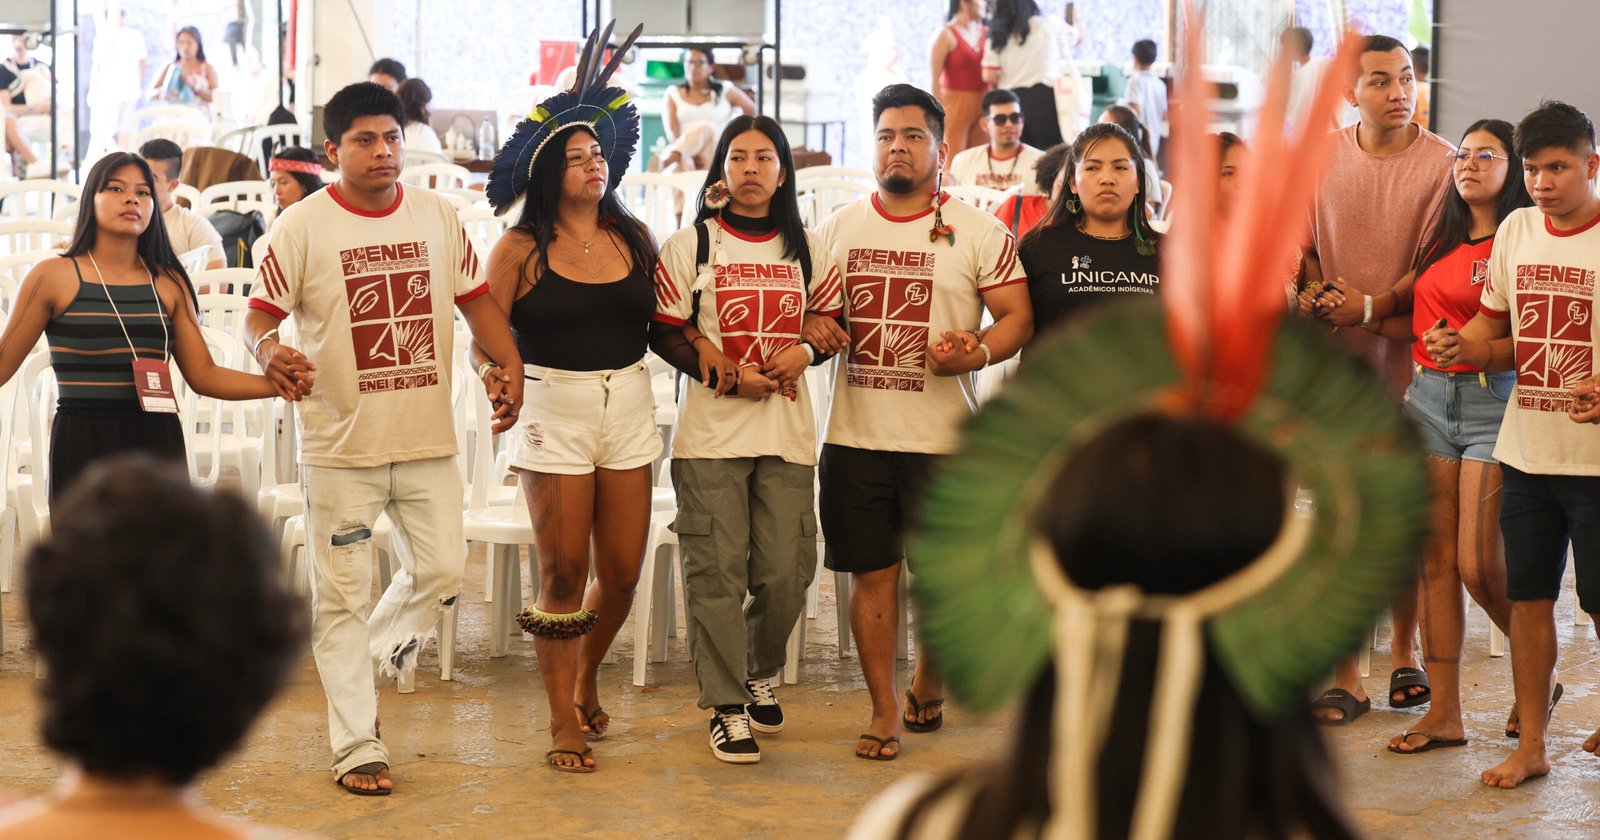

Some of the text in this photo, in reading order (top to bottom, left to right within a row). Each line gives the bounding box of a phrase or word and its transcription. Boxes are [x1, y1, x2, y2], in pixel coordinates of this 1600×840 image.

[365, 242, 420, 262] ENEI
[419, 241, 429, 257] 2024
[871, 249, 927, 267] ENEI
[926, 253, 936, 268] 2024
[740, 264, 793, 279] ENEI
[1061, 271, 1160, 286] UNICAMP
[1535, 264, 1587, 285] ENEI
[1586, 270, 1596, 287] 2024
[1068, 285, 1154, 295] ACADÊMICOS INDÍGENAS
[359, 378, 389, 391] ENEI
